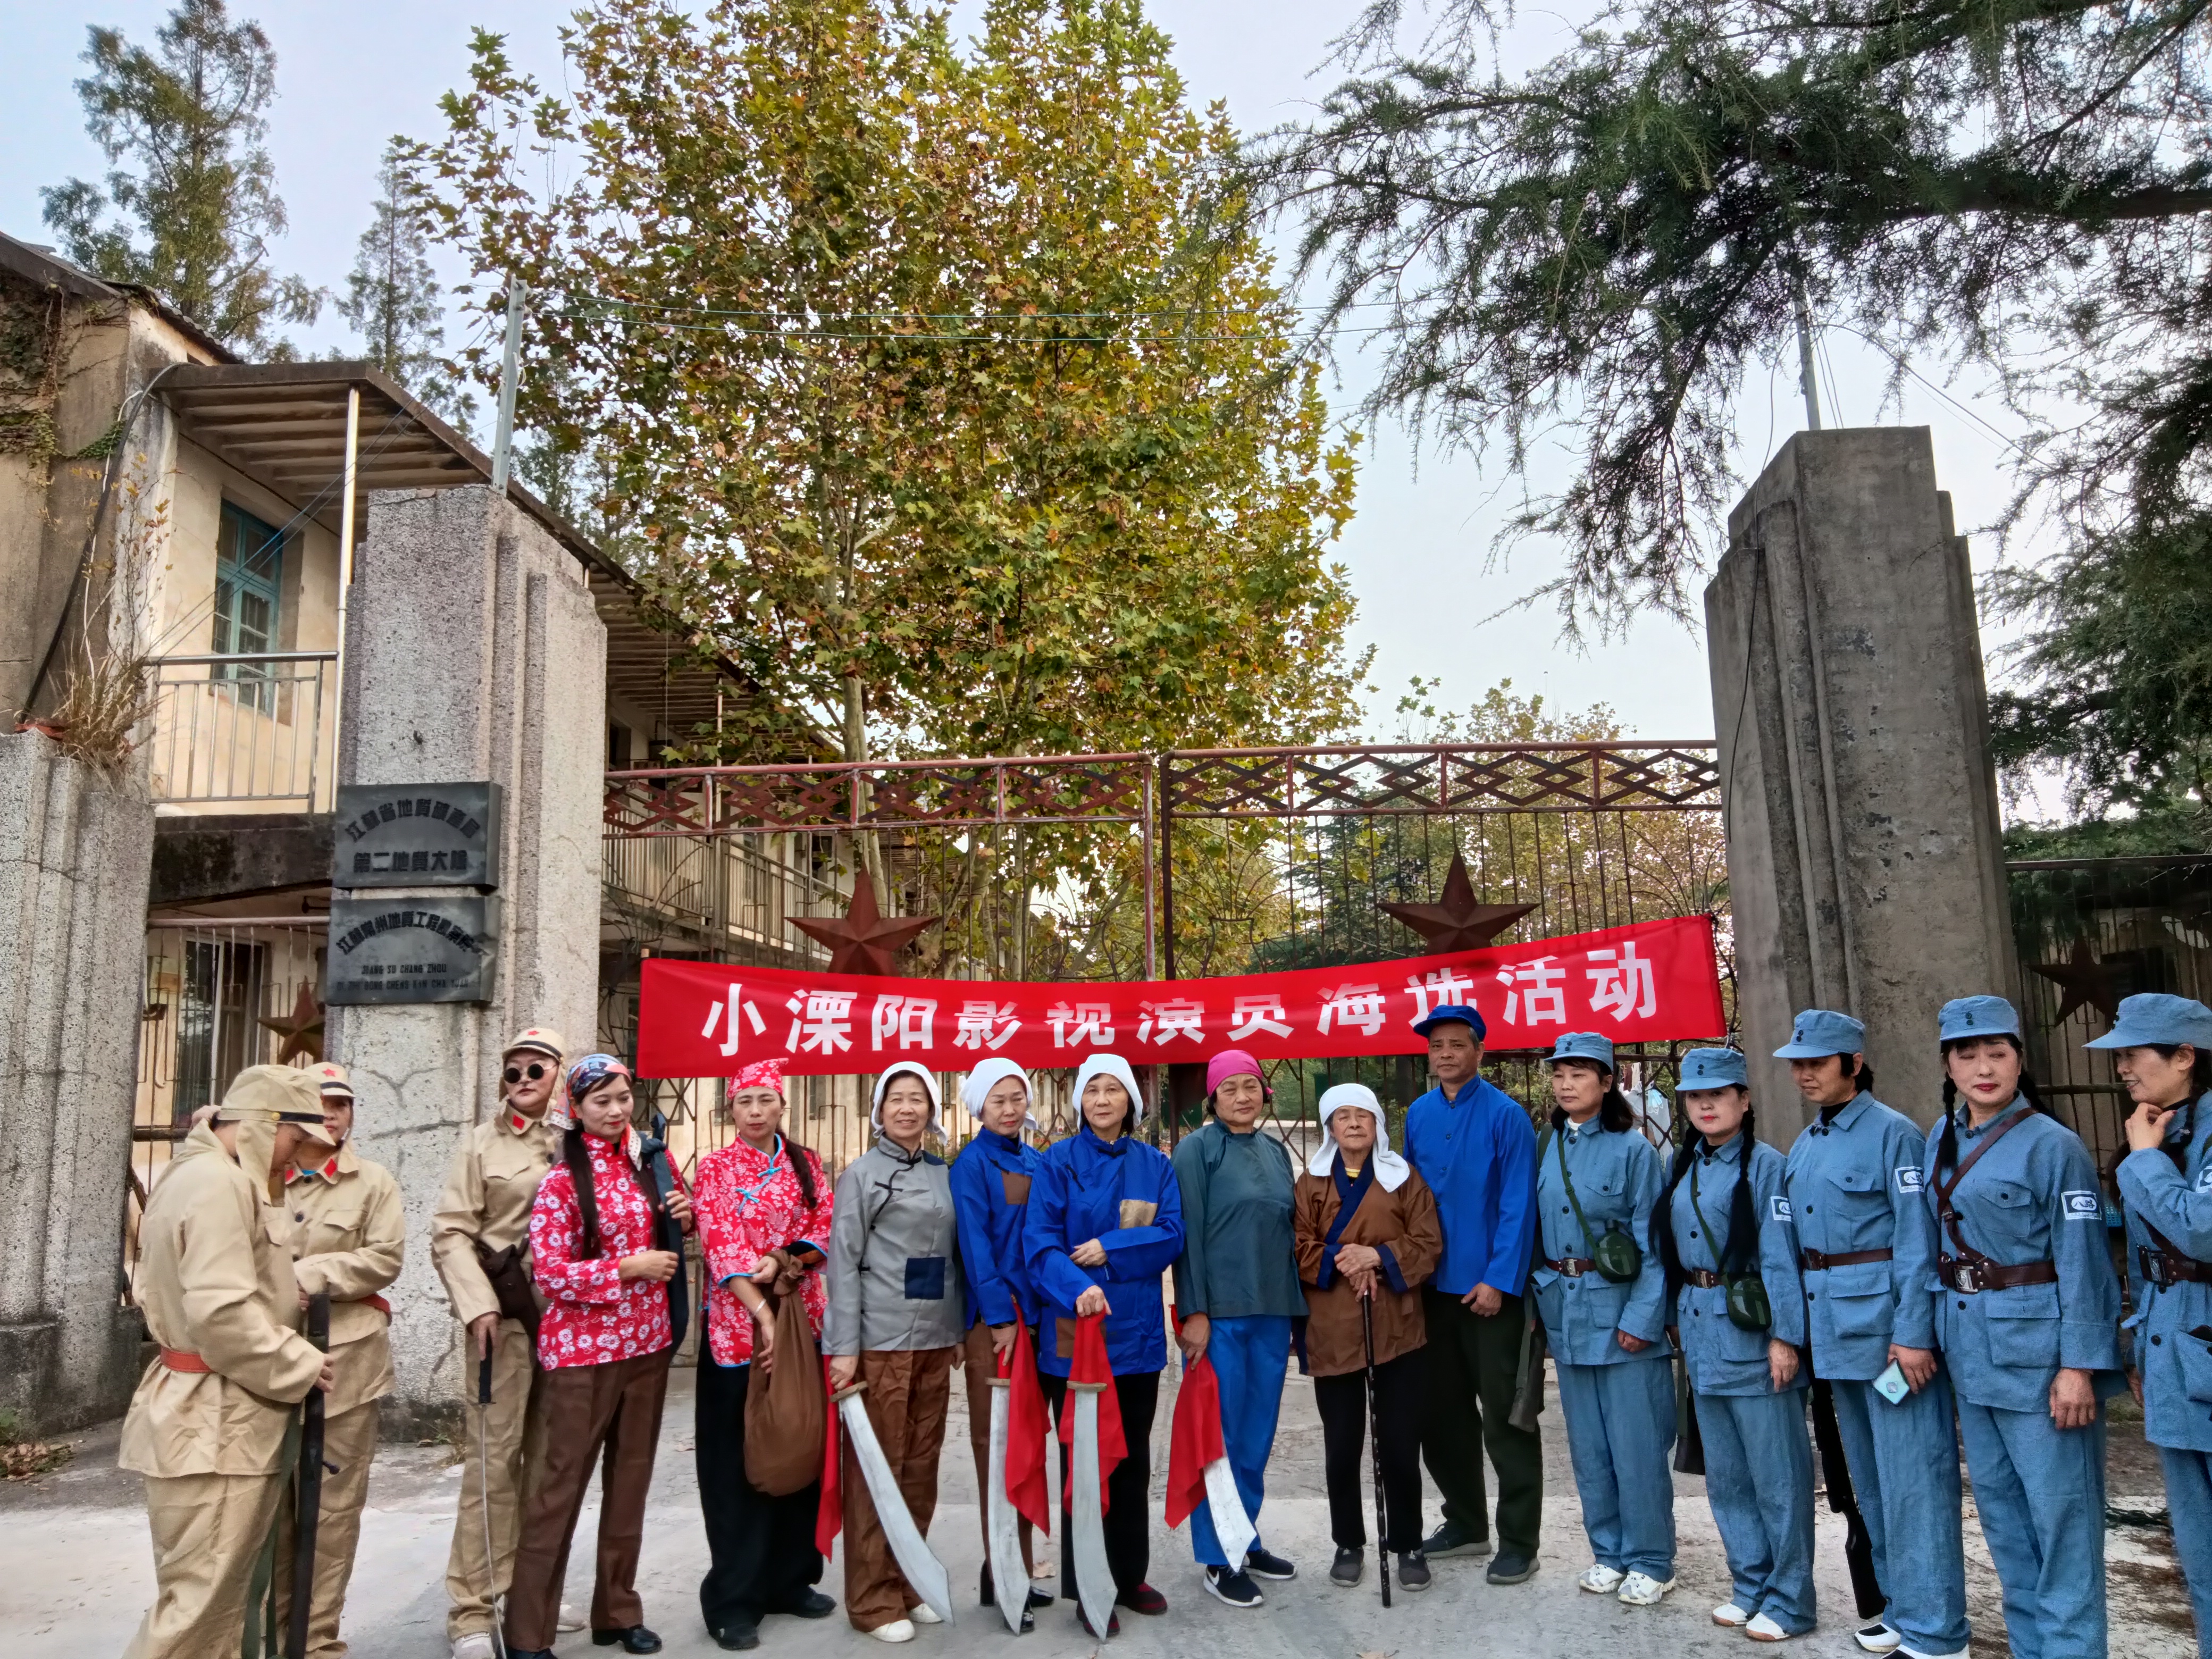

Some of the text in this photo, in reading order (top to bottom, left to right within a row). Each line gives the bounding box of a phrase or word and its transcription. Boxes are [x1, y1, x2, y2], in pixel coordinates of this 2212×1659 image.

[362, 963, 447, 975] JIANG SU CHANG ZHOU
[701, 941, 1657, 1057] 小溧阳影视演员海选活动
[2073, 1199, 2096, 1209] 八路
